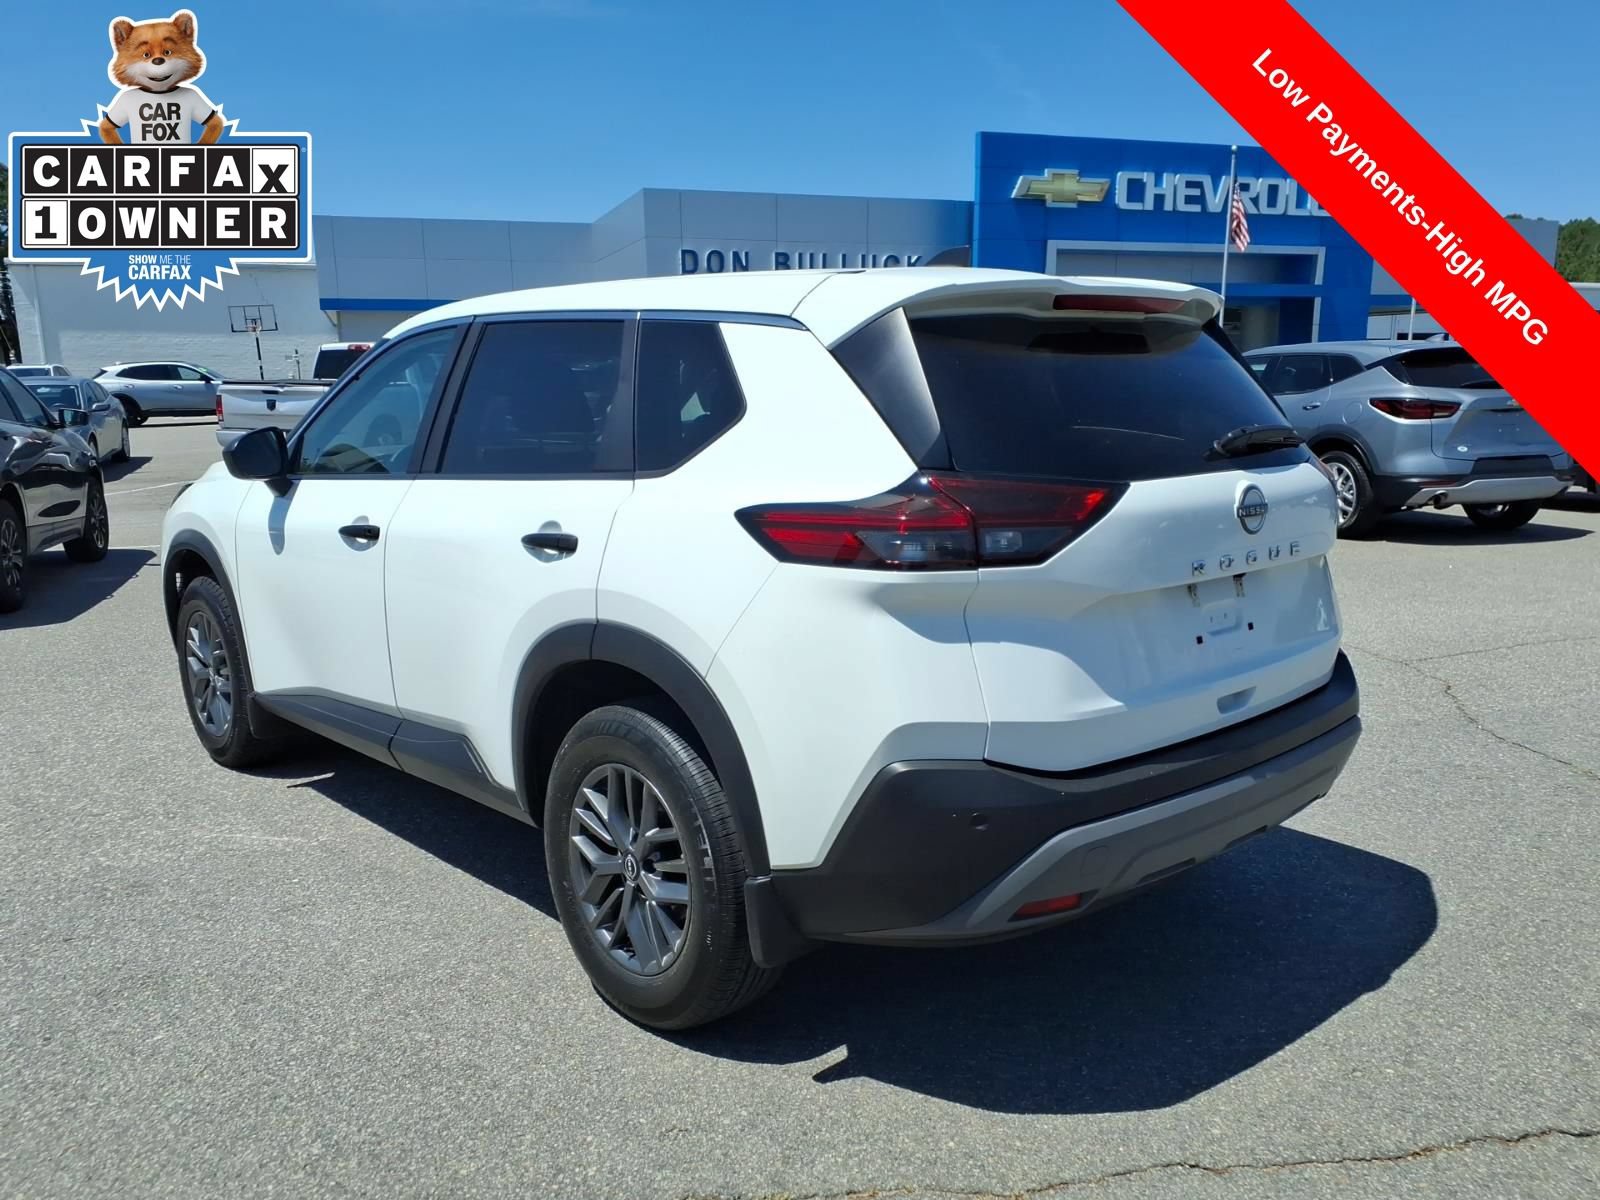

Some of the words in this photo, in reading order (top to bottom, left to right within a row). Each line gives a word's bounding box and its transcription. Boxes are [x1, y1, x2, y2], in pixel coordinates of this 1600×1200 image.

[680, 248, 750, 275] DON
[1239, 506, 1266, 516] NISS
[1191, 541, 1301, 576] ROGUE
